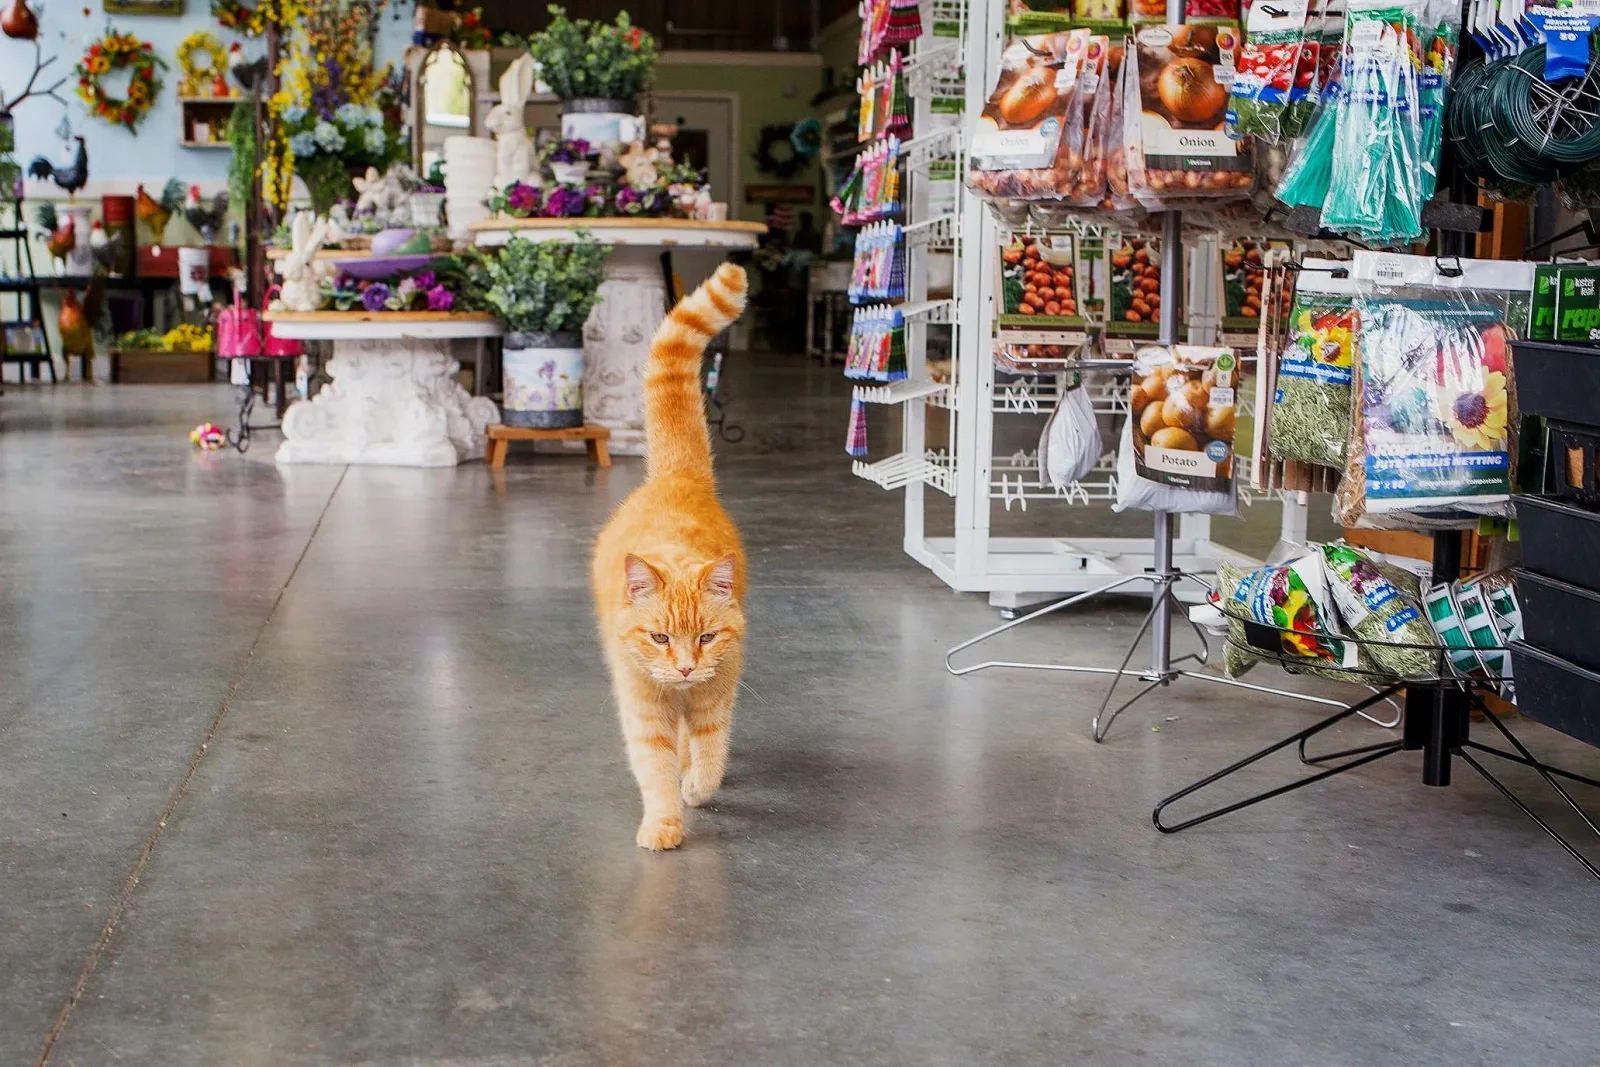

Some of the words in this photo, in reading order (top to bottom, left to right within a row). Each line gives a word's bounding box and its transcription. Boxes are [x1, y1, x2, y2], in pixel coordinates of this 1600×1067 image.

[1180, 136, 1215, 147] Onion
[1162, 454, 1197, 467] Potato
[1451, 455, 1502, 467] NETTING
